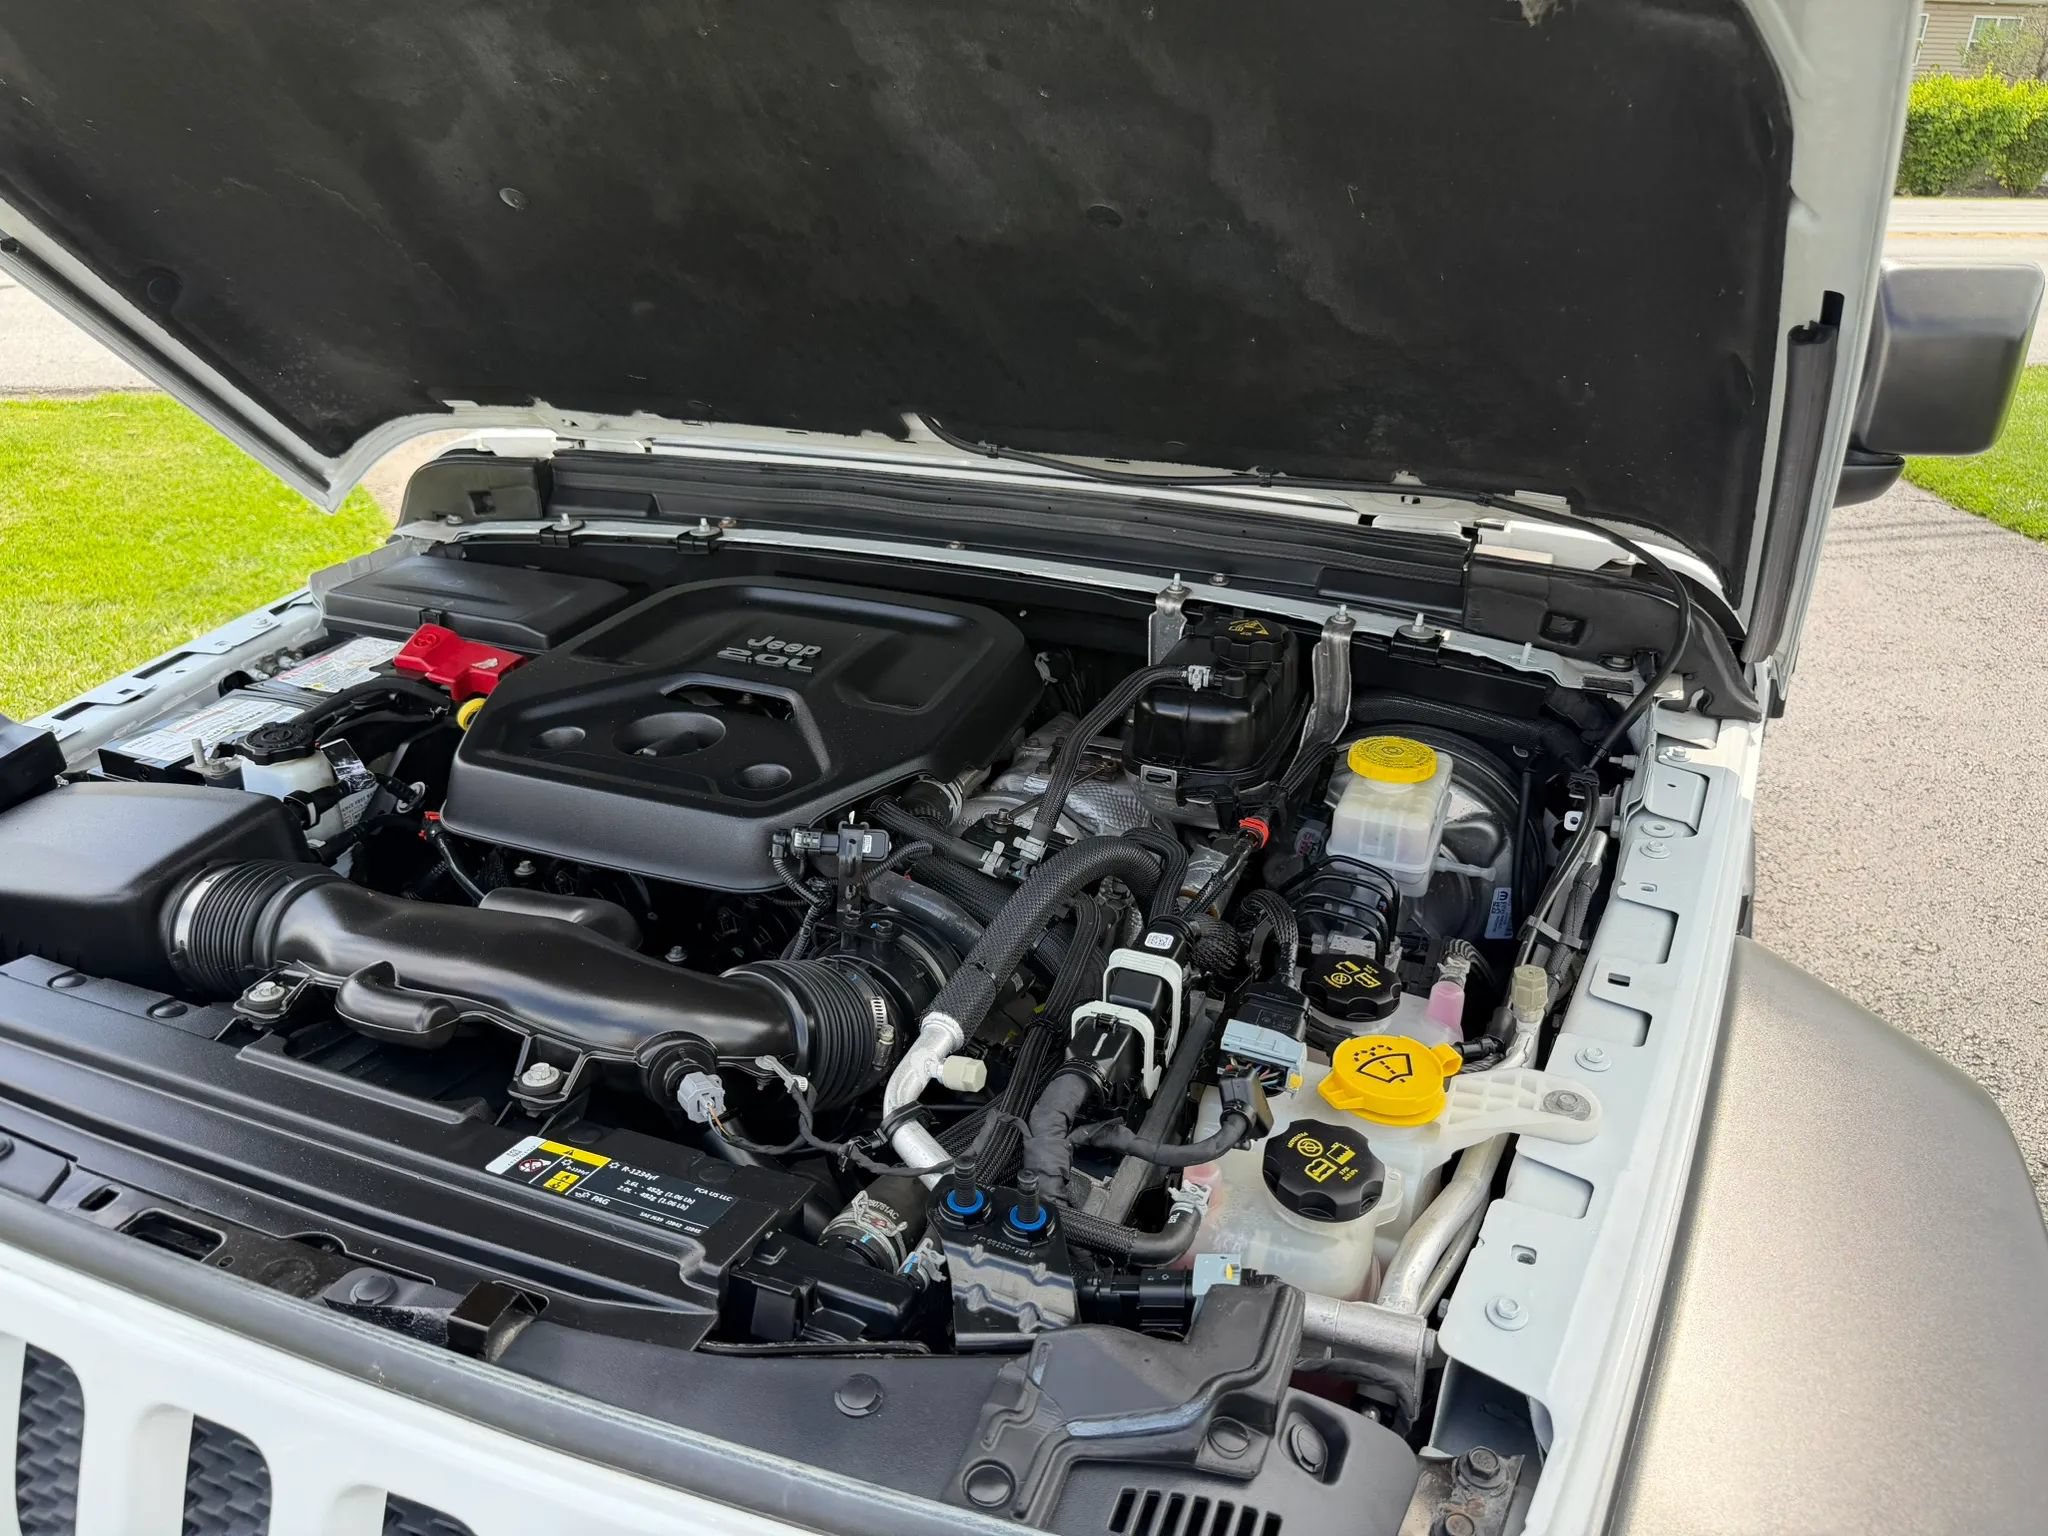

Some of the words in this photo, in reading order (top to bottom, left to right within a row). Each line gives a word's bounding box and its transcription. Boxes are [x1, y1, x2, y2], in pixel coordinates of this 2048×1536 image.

[747, 635, 822, 657] Jeep
[717, 646, 814, 672] 2.0L
[621, 1166, 660, 1181] R-1234yf
[617, 1185, 632, 1193] 2.0L
[624, 1179, 639, 1188] 3.6L
[590, 1195, 611, 1205] PAG
[694, 1187, 709, 1195] FCA
[719, 1194, 733, 1202] LLC
